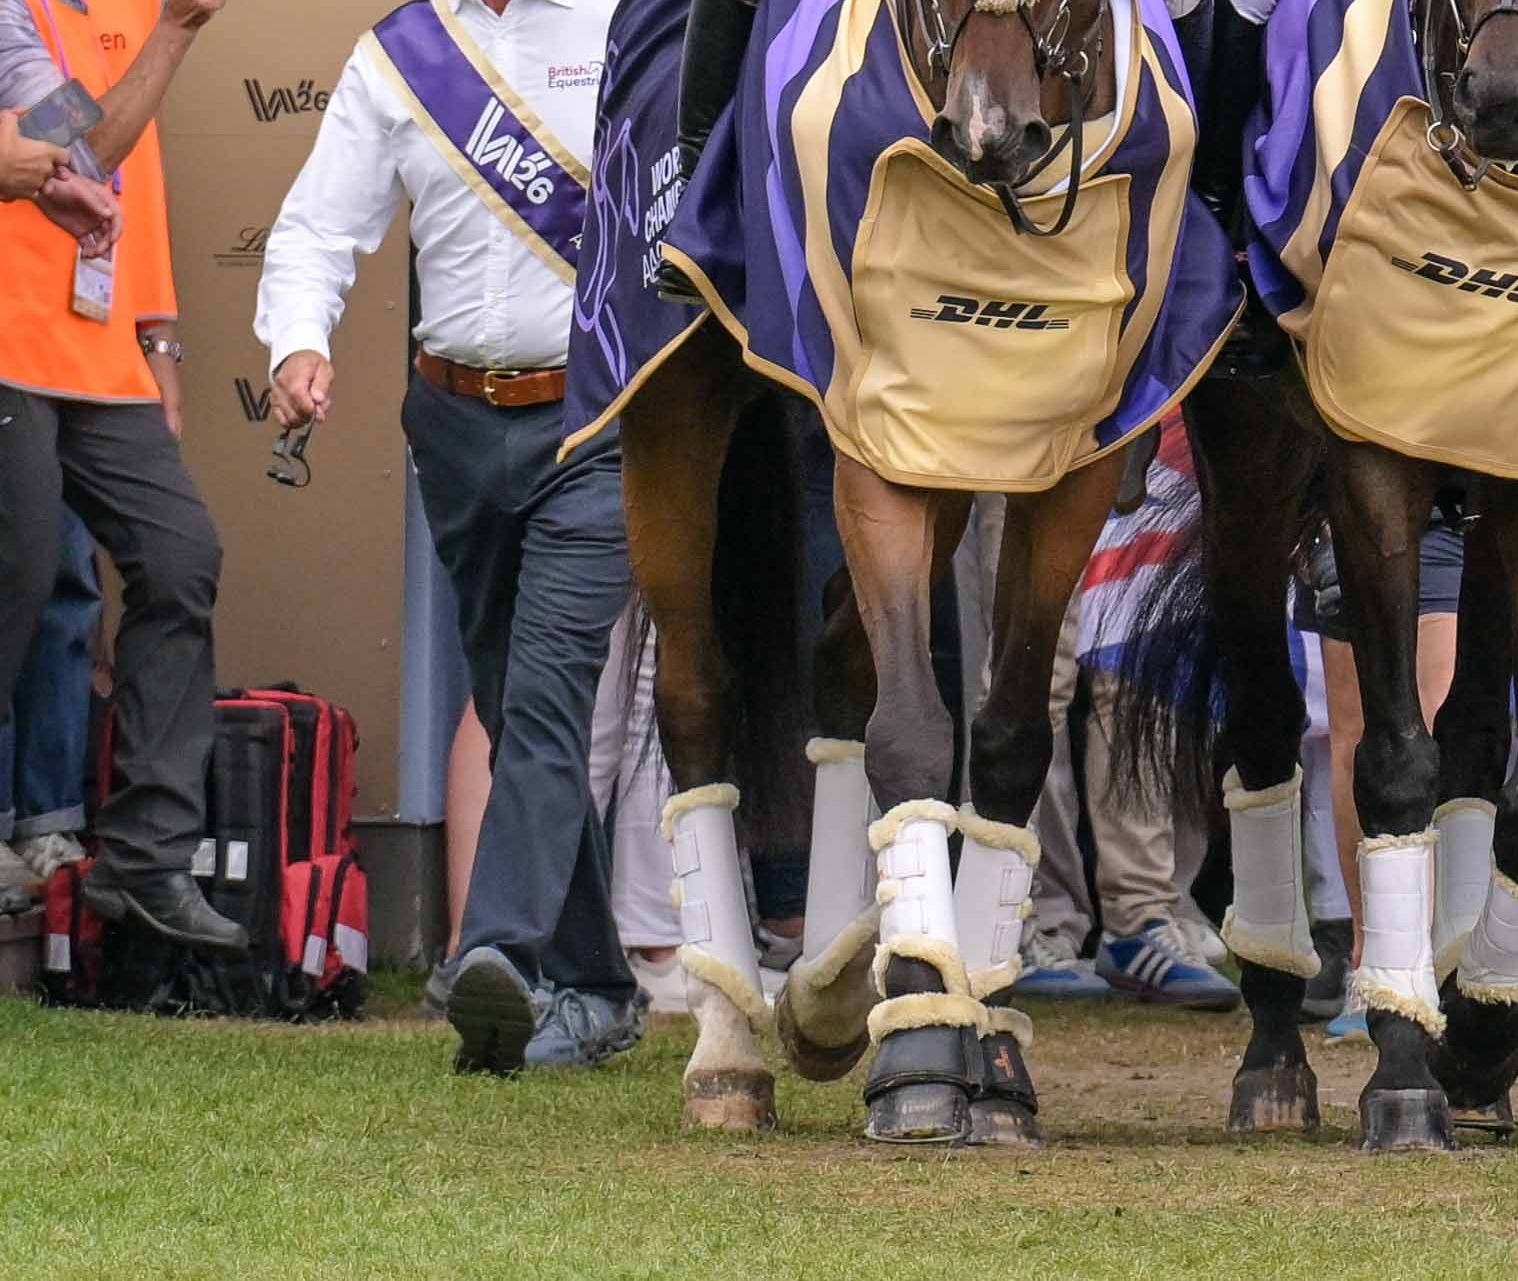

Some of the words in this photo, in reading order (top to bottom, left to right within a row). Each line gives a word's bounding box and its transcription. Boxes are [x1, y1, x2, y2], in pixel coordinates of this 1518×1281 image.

[548, 65, 587, 77] British
[548, 78, 601, 90] Equestri
[651, 146, 682, 196] WOR
[934, 295, 1050, 330] DHL
